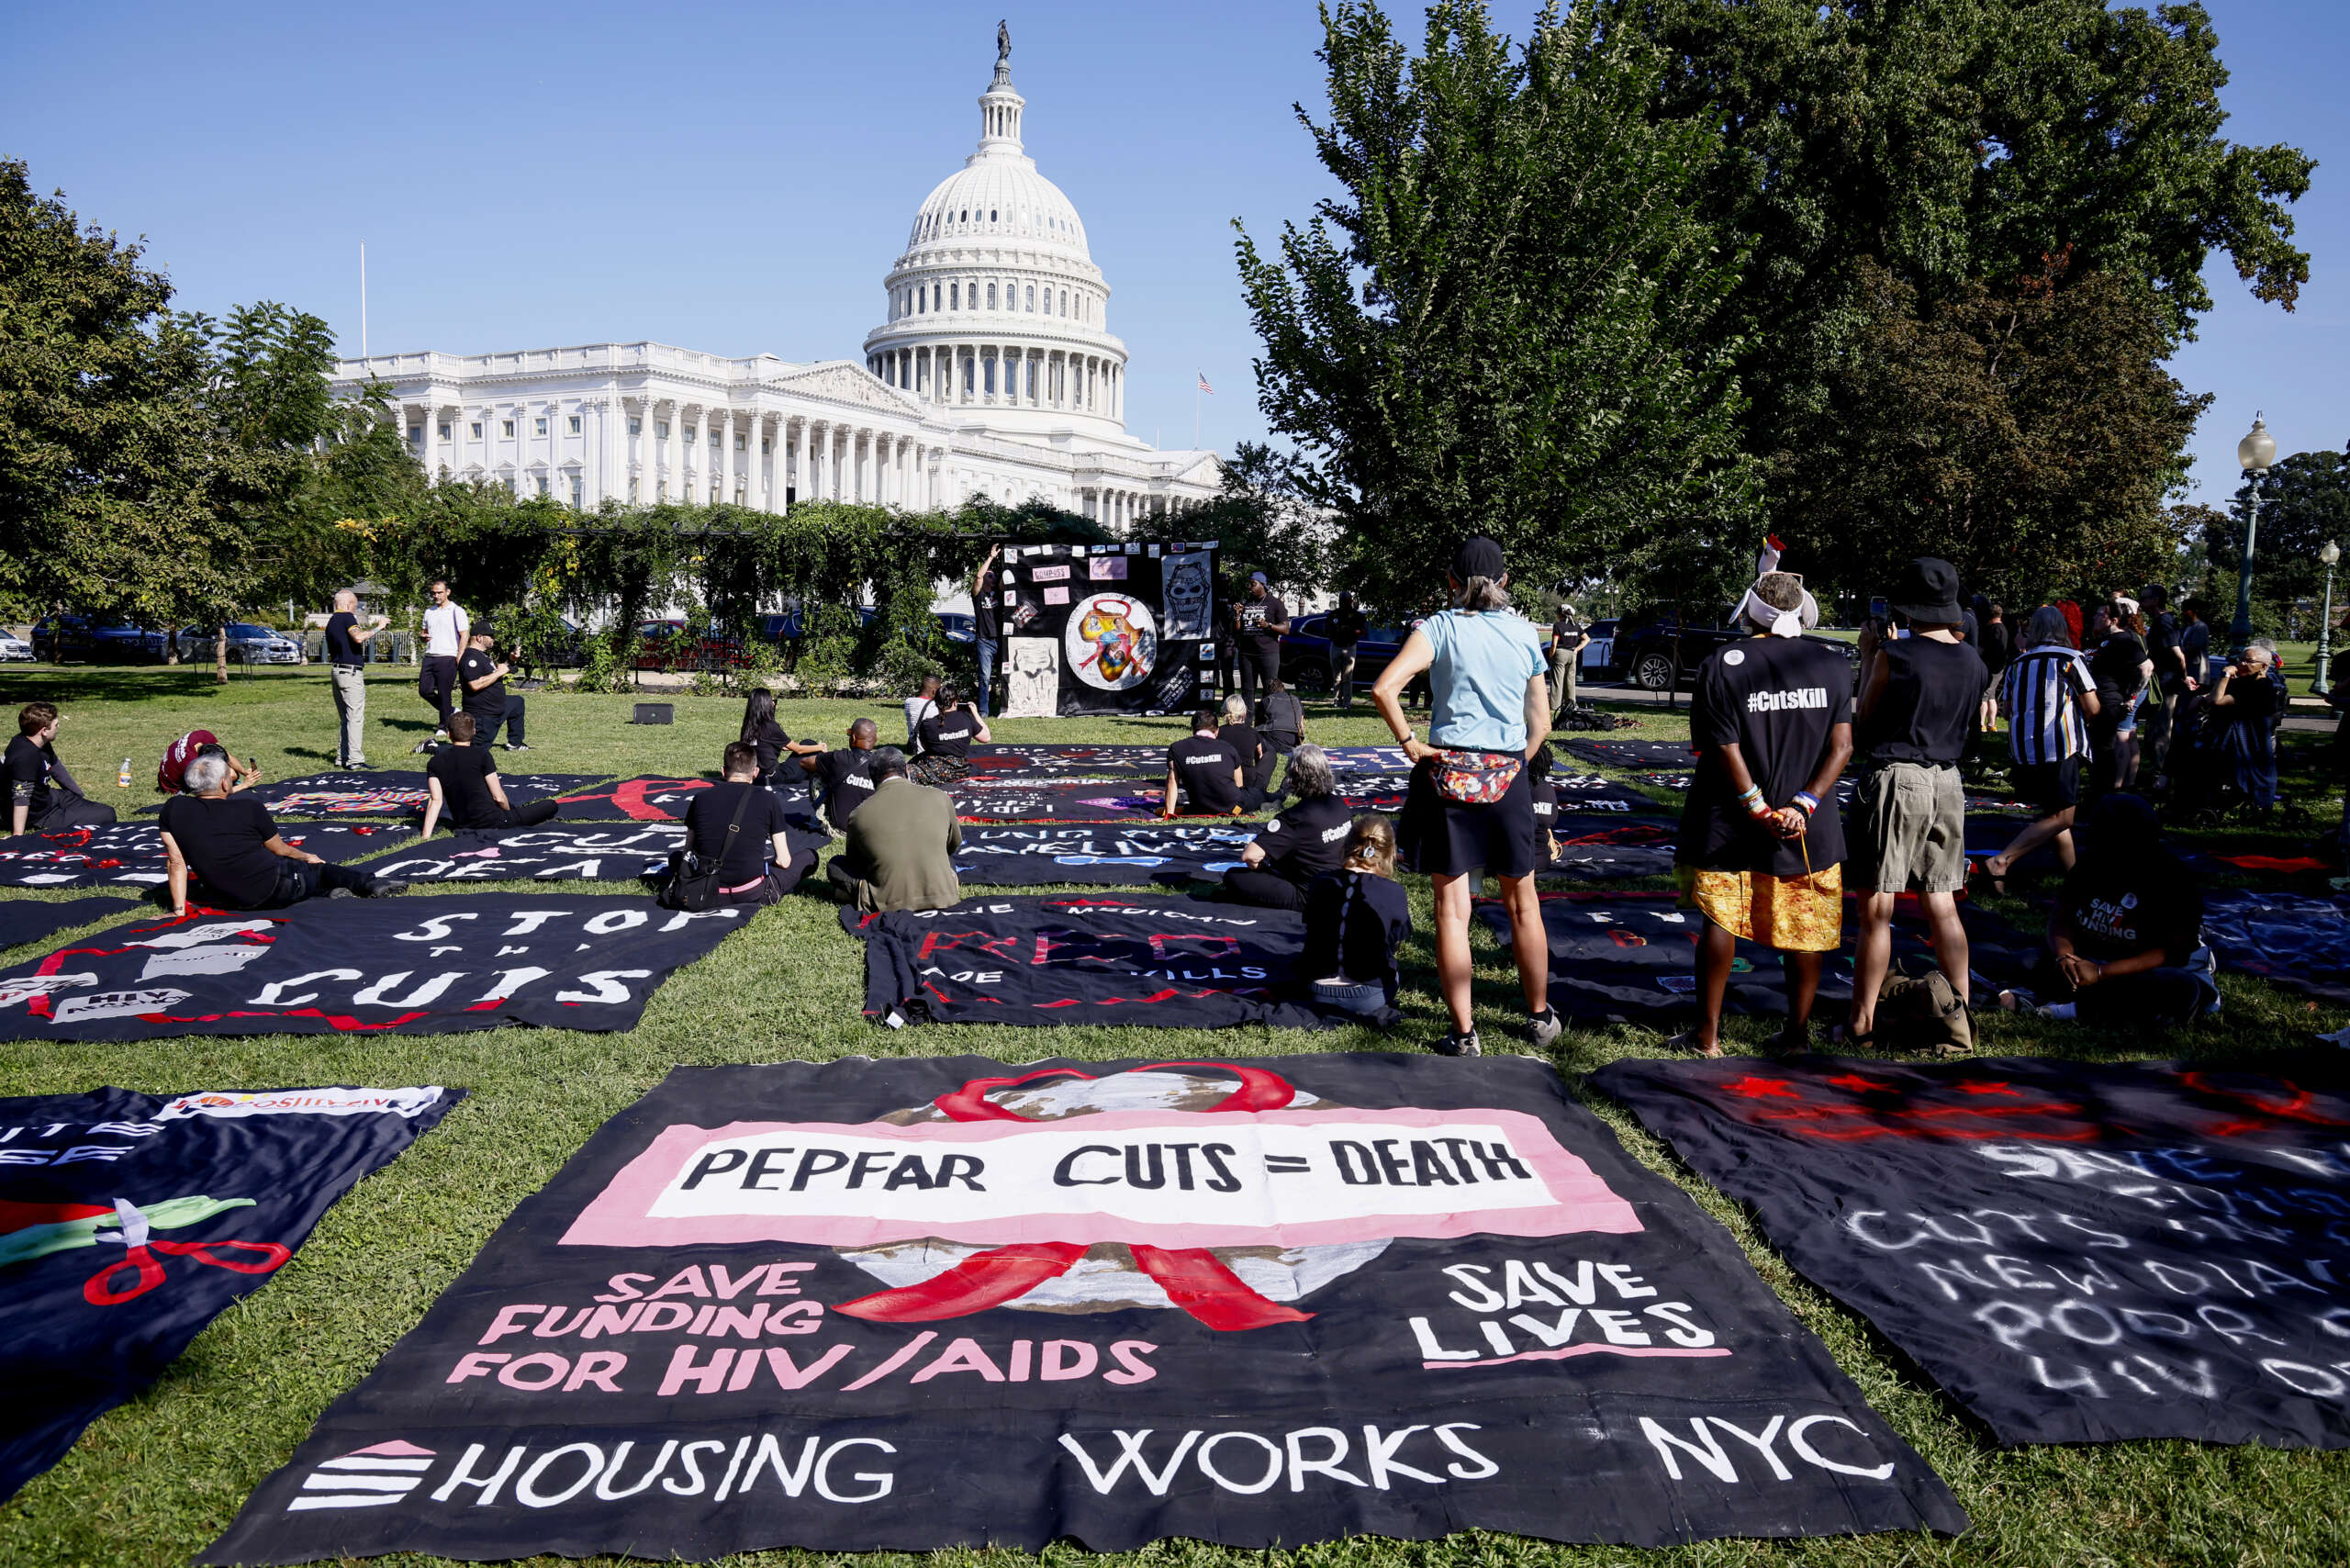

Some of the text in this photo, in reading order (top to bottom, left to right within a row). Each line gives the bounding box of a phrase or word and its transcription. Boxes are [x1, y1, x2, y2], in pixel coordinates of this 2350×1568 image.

[1747, 688, 1828, 713] #CutsKill
[938, 728, 969, 741] #CutsKill
[1185, 754, 1222, 765] #CutsKill
[2090, 898, 2123, 916] SAVE
[2092, 909, 2115, 924] HIV
[89, 991, 171, 1004] HIV
[248, 966, 652, 1008] CUTS
[680, 1137, 1532, 1193] PEPFAR CUTS = DEATH
[1844, 1210, 2130, 1250] CUTS
[593, 1262, 817, 1303] SAVE
[1442, 1260, 1658, 1314] SAVE
[1918, 1253, 2119, 1302] NEW
[477, 1300, 825, 1345] FUNDING
[1409, 1302, 1716, 1362] LIVES
[446, 1330, 1159, 1396] FOR HIV/AIDS
[429, 1415, 1895, 1507] HOUSING WORKS NYC
